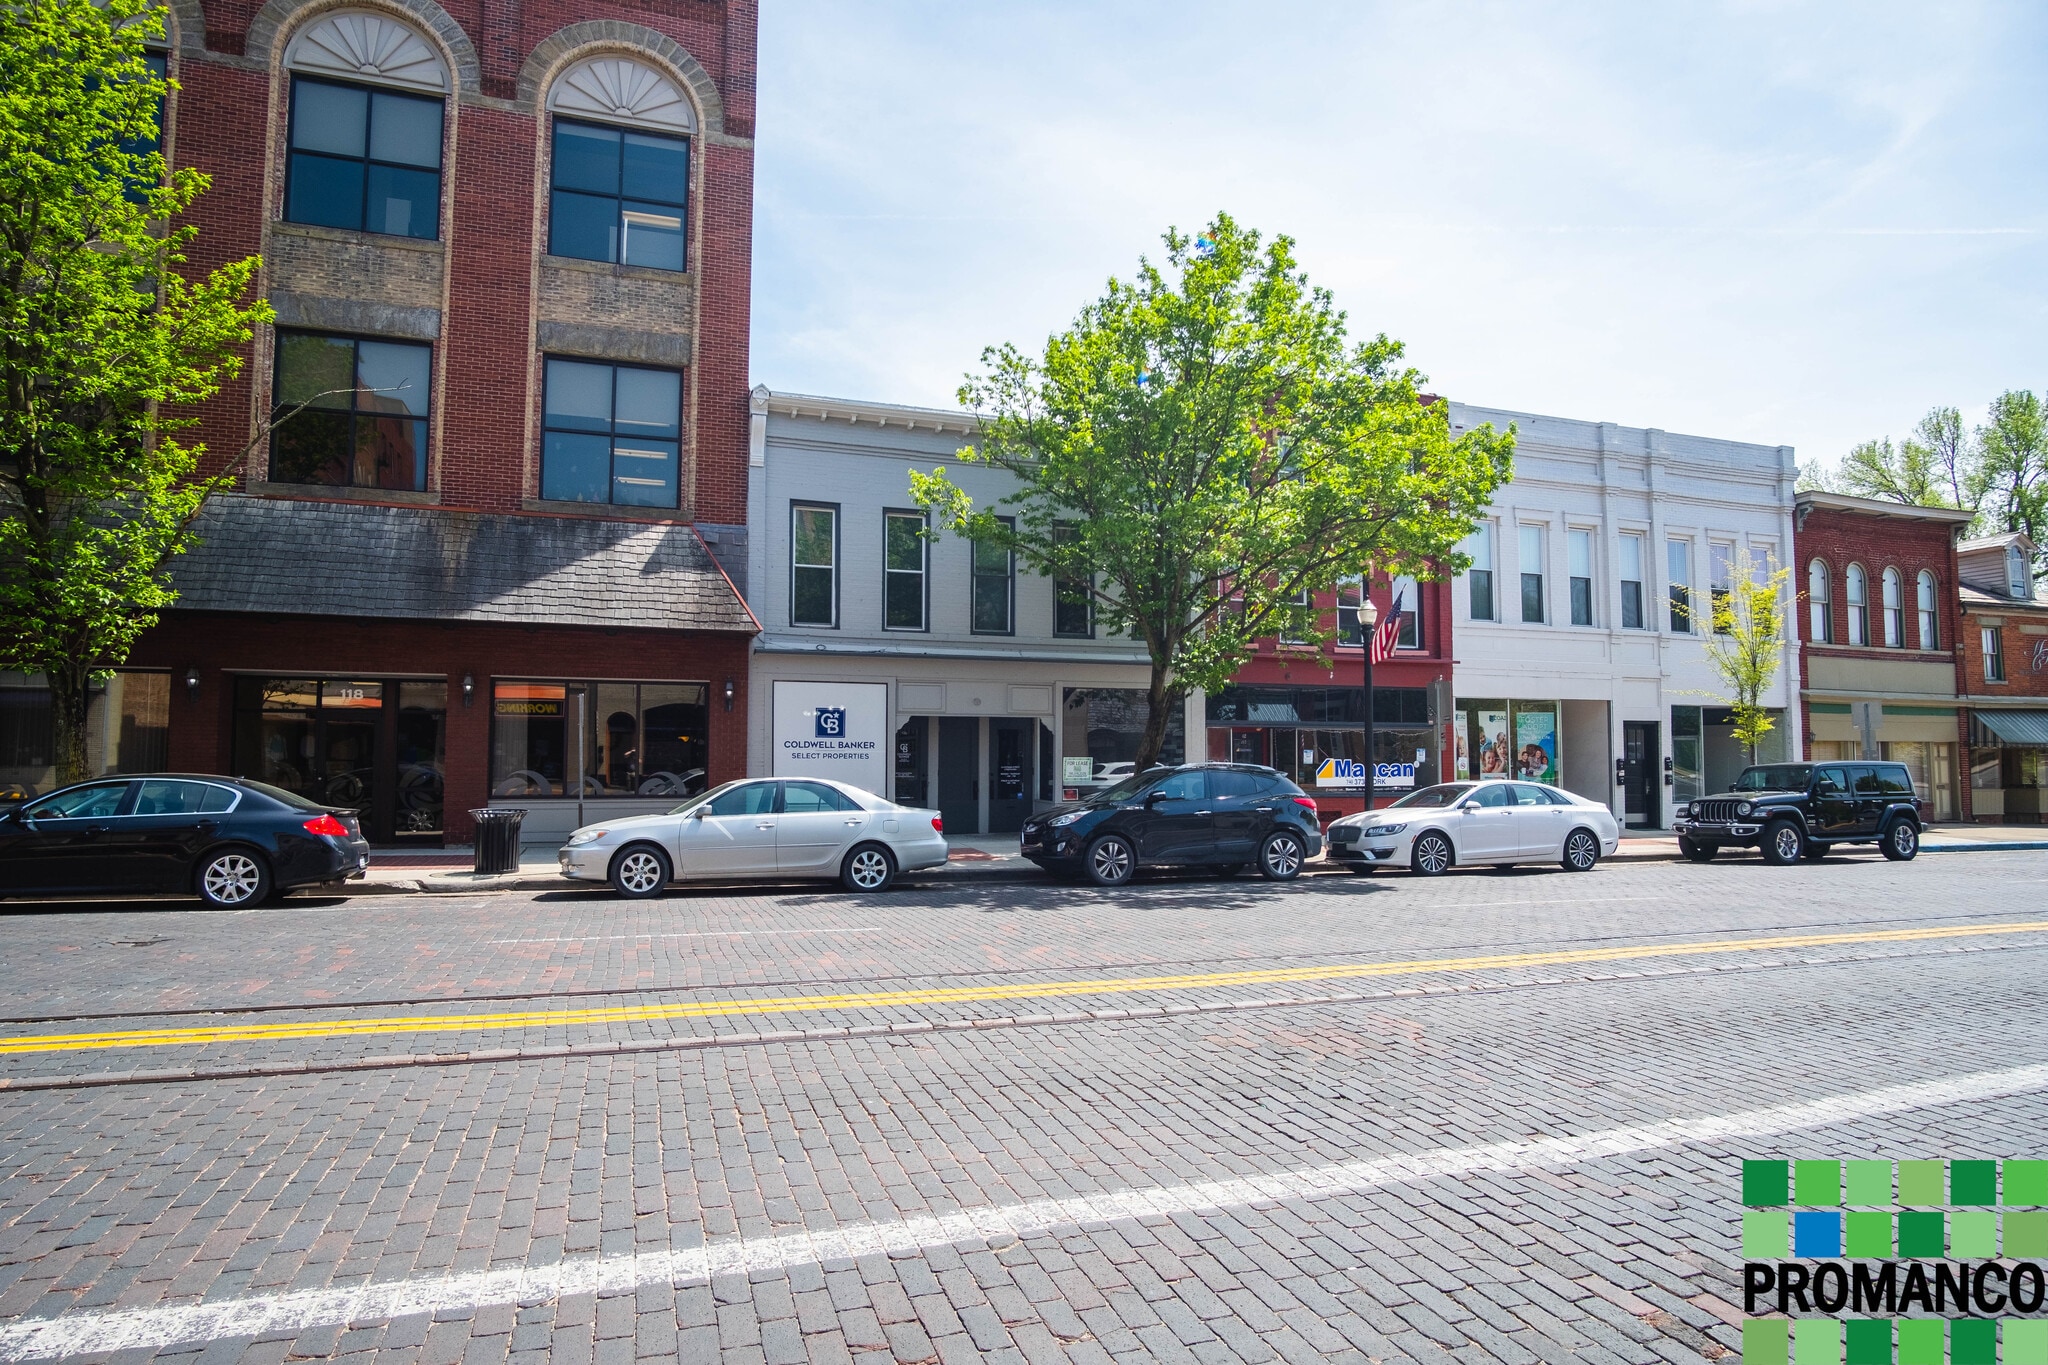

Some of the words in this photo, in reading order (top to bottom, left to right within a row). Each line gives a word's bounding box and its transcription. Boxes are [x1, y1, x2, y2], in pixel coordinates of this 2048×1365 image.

[340, 688, 364, 700] 118
[783, 740, 836, 749] COLDWELL
[838, 741, 875, 749] BANKER
[791, 752, 820, 760] SELECT
[822, 752, 870, 760] PROPERTIES
